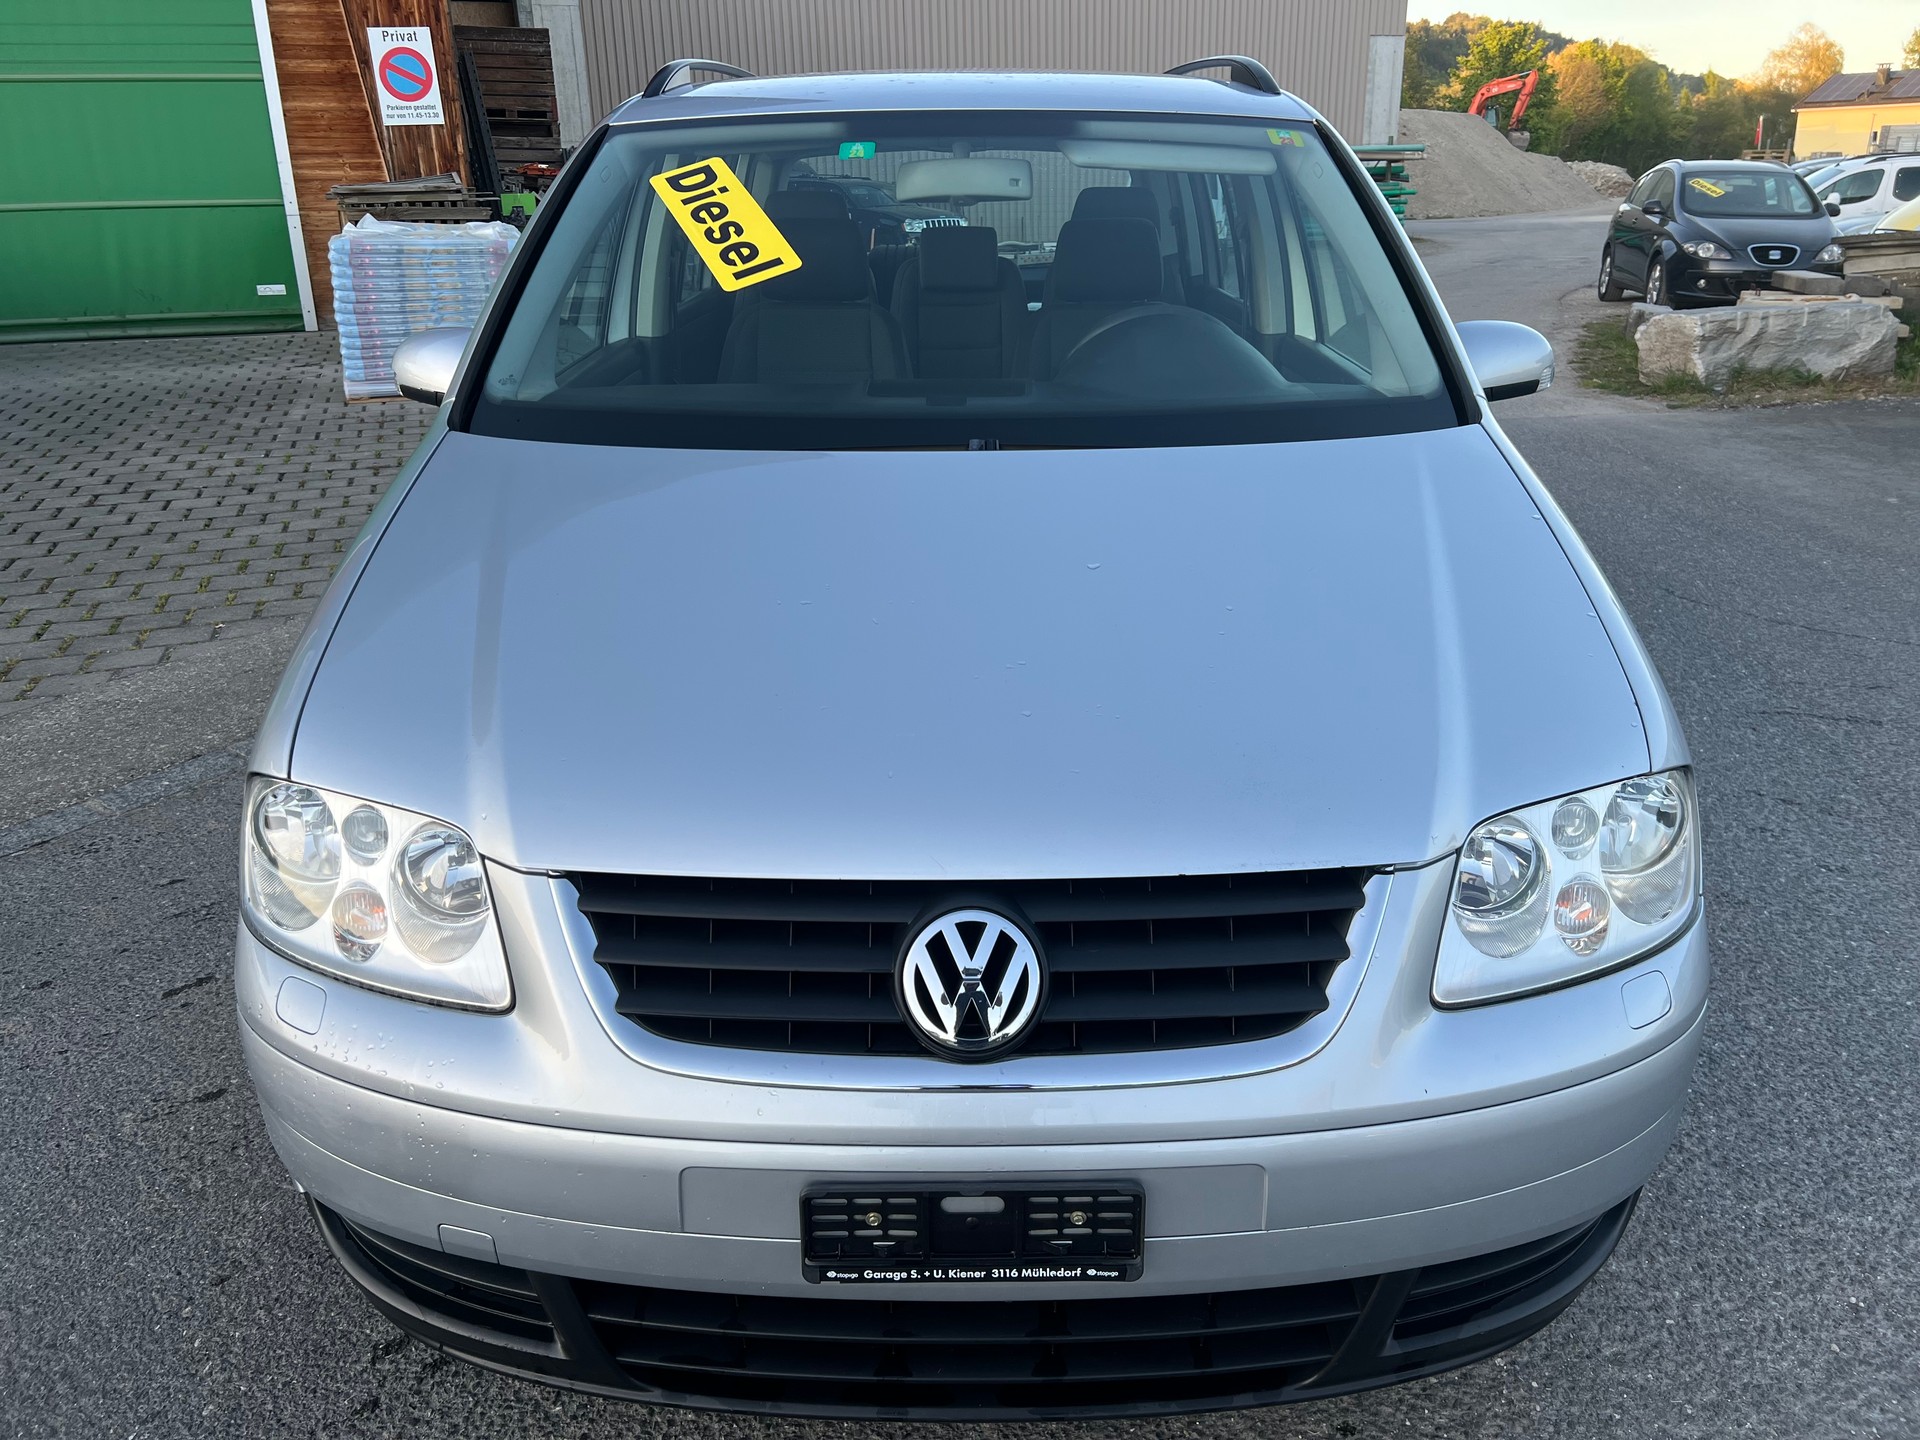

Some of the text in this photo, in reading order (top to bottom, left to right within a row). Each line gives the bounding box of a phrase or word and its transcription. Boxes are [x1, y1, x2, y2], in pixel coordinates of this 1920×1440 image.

[381, 30, 418, 42] Privat
[414, 104, 437, 112] gestattet
[1690, 179, 1723, 196] Diesel
[664, 164, 784, 281] Diesel
[863, 1269, 908, 1281] Garage
[910, 1269, 921, 1279] S.
[923, 1270, 931, 1278] +
[933, 1269, 946, 1279] U.
[948, 1268, 987, 1279] Kiener
[991, 1268, 1019, 1278] 3116
[1021, 1267, 1082, 1278] Mühledorf
